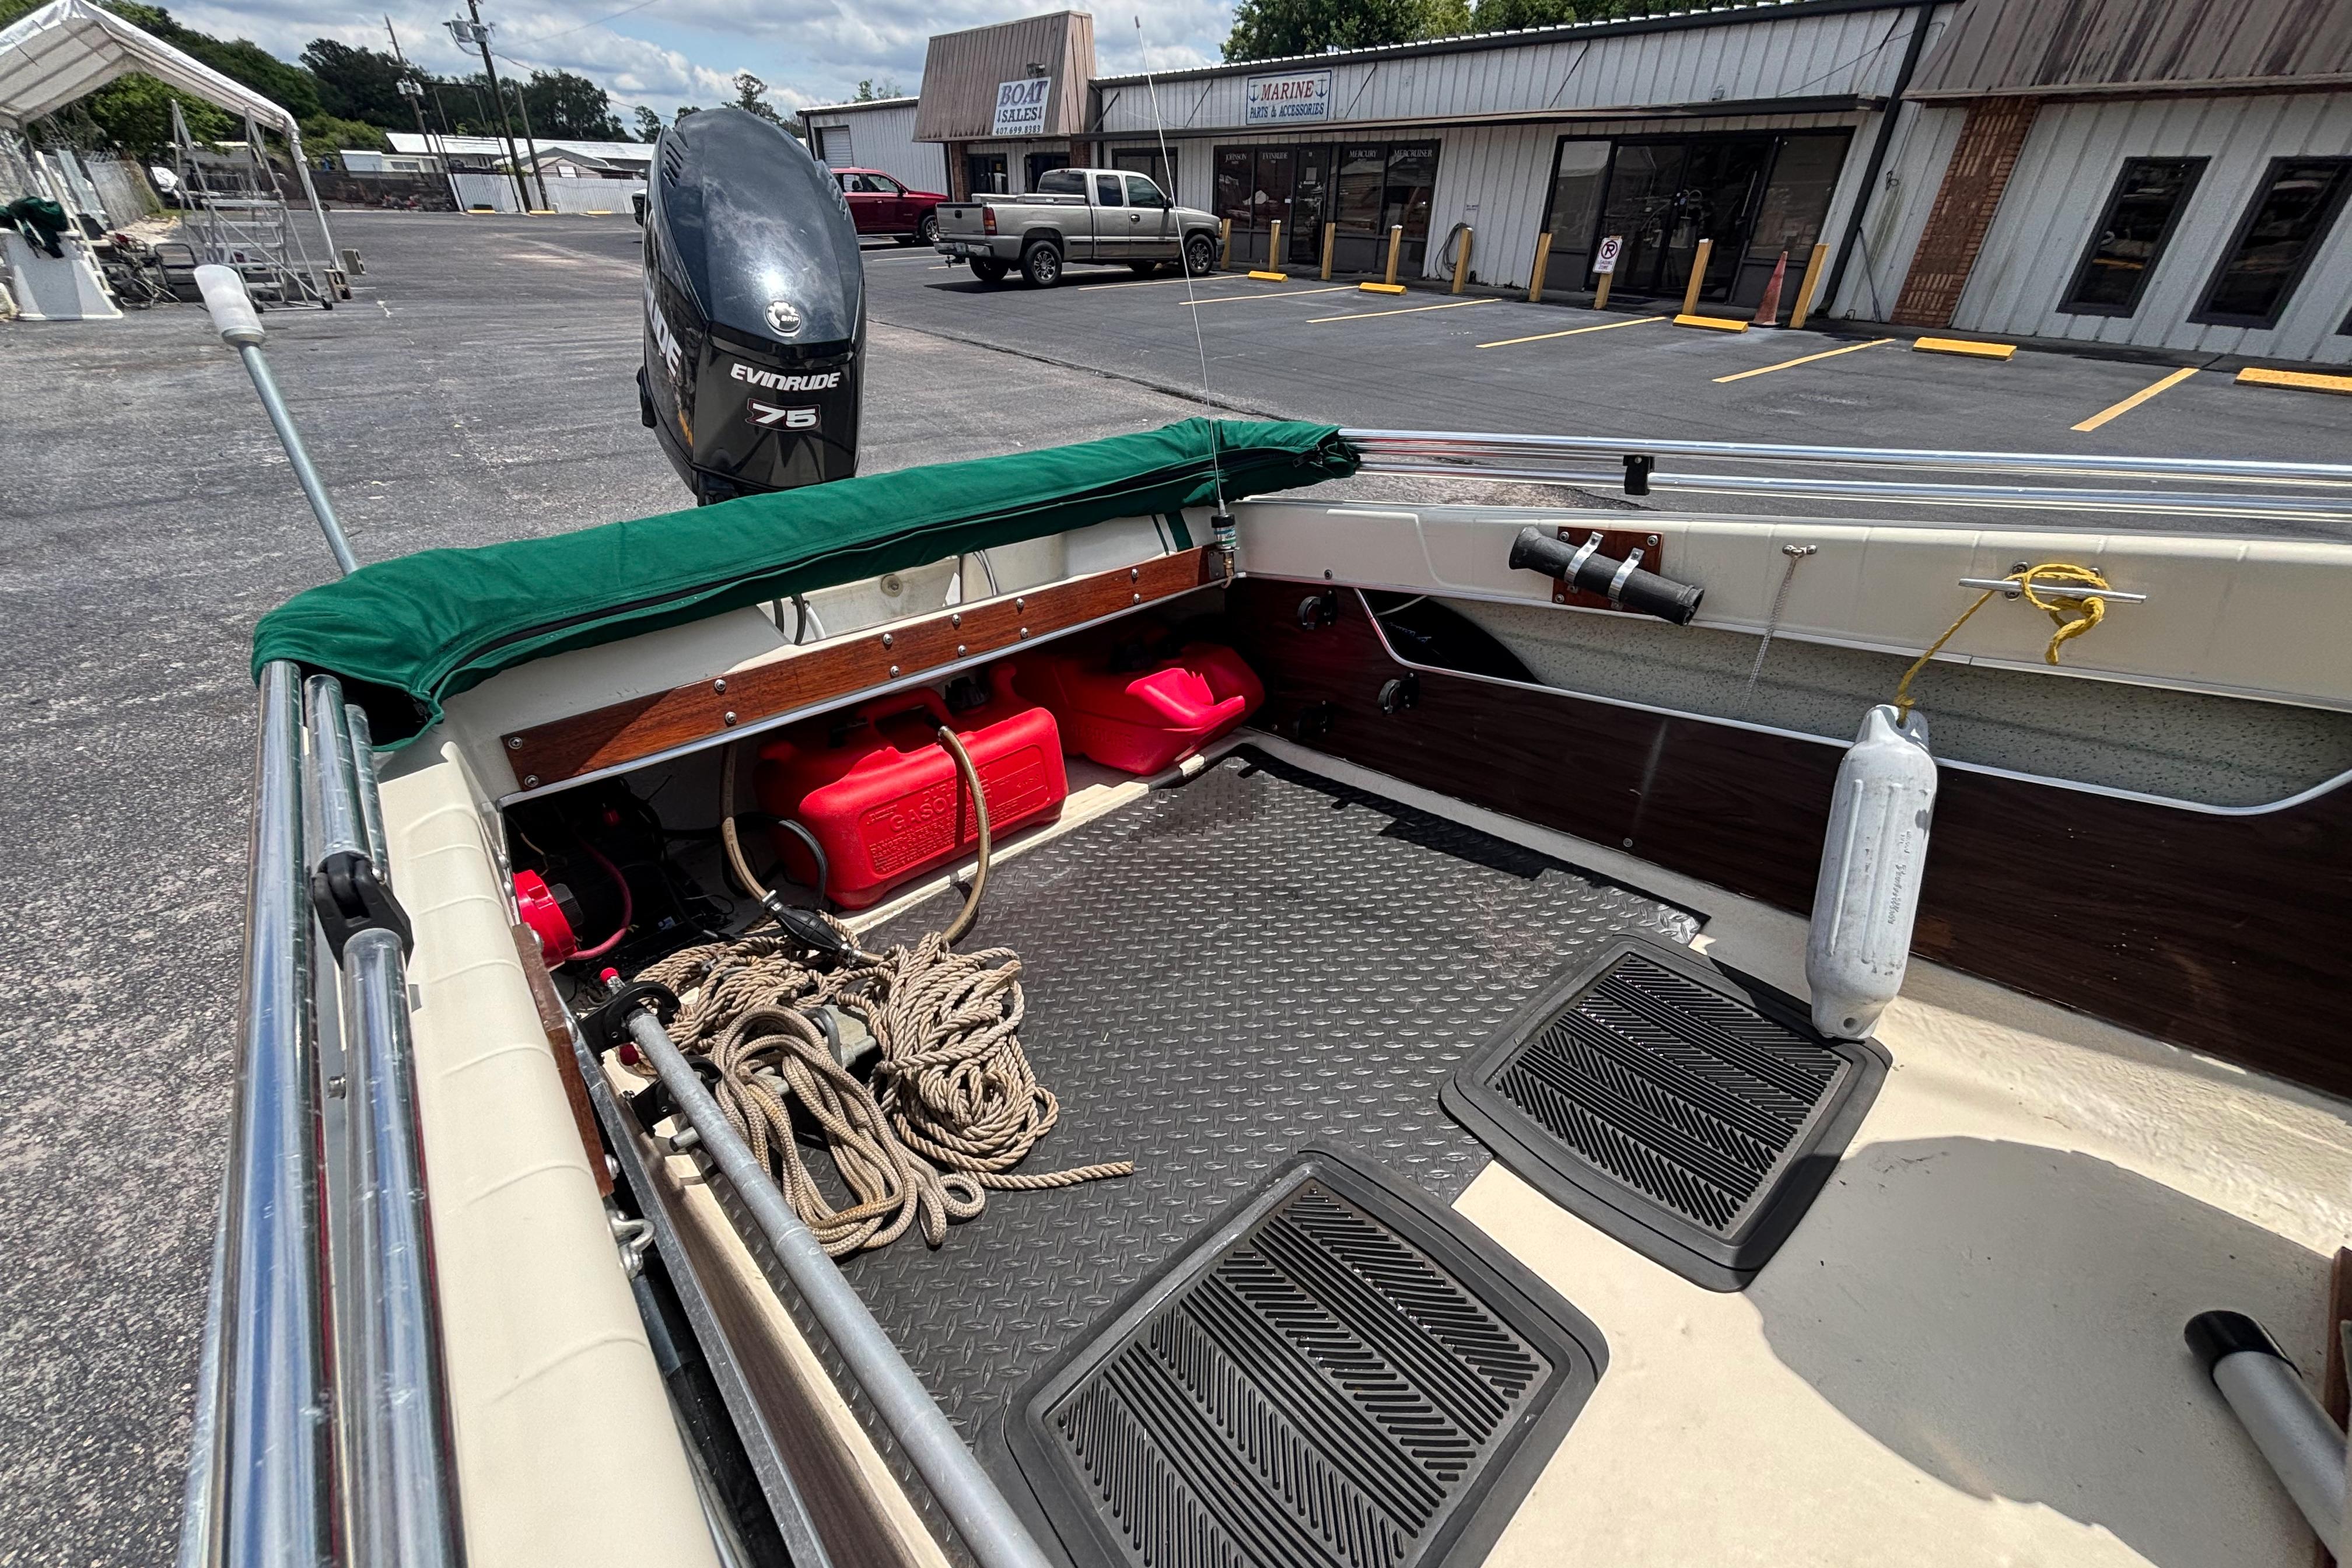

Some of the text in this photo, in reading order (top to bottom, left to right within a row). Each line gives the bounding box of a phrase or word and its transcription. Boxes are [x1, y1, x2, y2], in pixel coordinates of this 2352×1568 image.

[998, 80, 1048, 107] BOAT
[1261, 80, 1314, 101] MARINE
[1250, 102, 1324, 118] PARTS & ACCESSORIES
[1226, 153, 1247, 162] JOHNSON
[1349, 150, 1378, 158] MERCURY
[730, 363, 841, 391] EVINRUDE
[752, 403, 817, 428] 75
